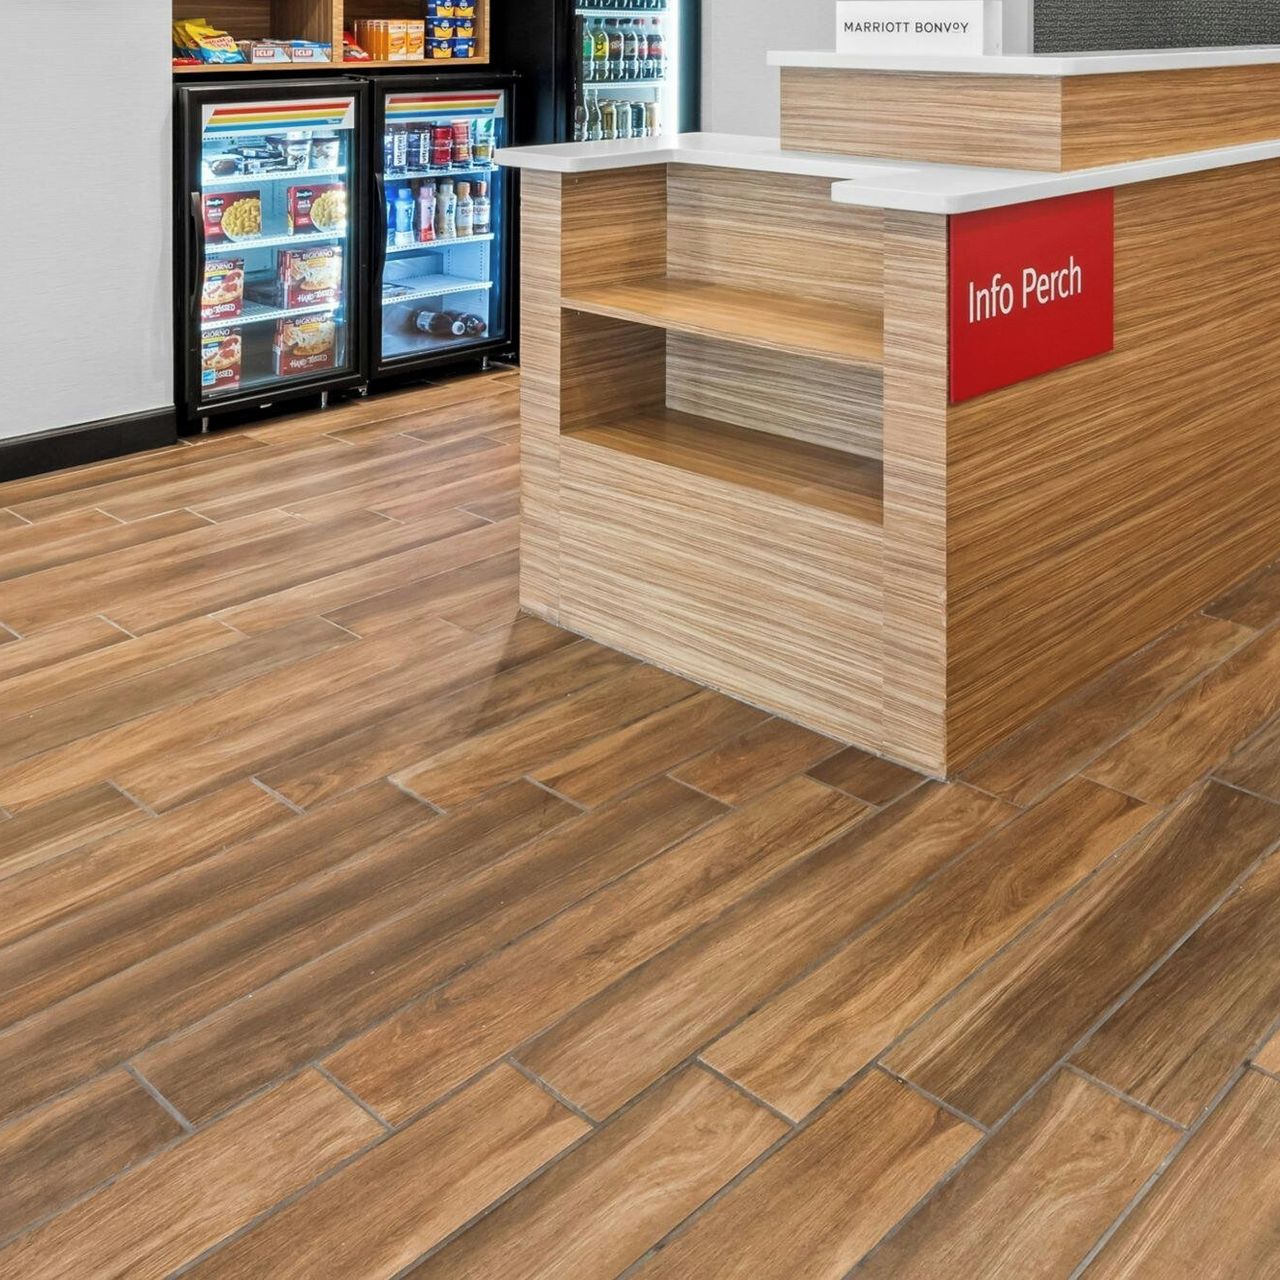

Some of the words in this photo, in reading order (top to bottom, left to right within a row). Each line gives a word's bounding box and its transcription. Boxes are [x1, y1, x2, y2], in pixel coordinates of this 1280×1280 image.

[844, 22, 910, 33] MARRIOTT
[915, 22, 969, 33] BONVOY
[969, 273, 1014, 324] Info
[1022, 255, 1082, 309] Perch
